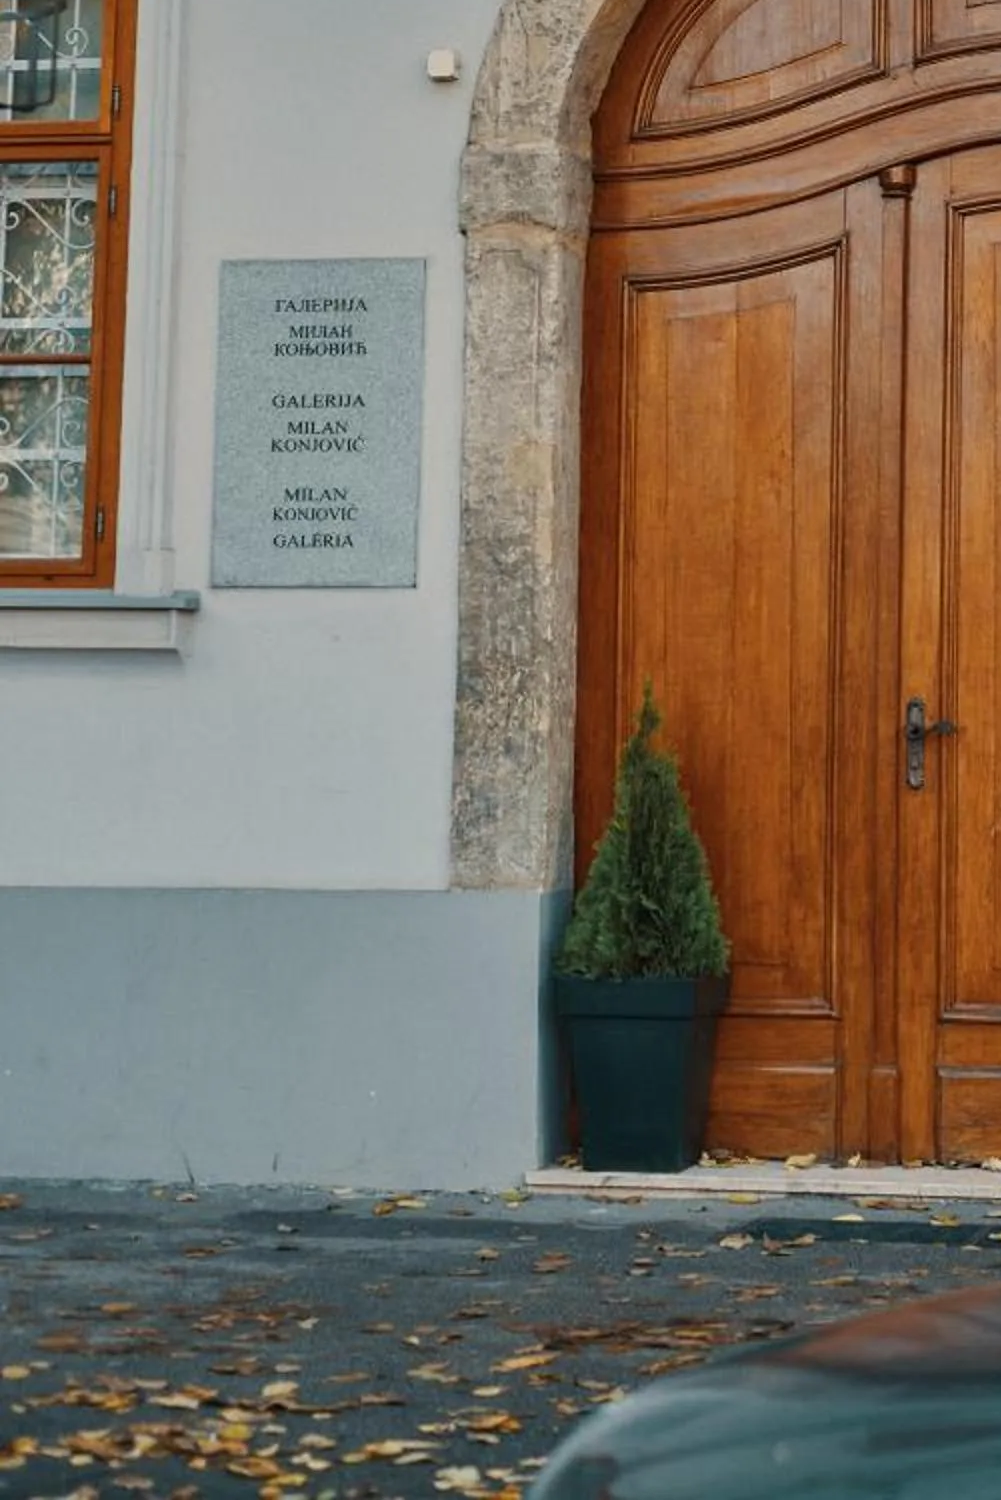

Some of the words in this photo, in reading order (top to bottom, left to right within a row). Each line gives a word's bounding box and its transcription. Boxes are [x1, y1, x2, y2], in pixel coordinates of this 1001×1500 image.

[275, 298, 367, 313] ГАЛЕРИЈА
[289, 324, 353, 339] МИЛАН
[274, 341, 367, 357] КОЊОВИЋ
[272, 394, 365, 409] GALERIJA
[287, 421, 349, 435] MILAN
[271, 436, 366, 453] KONJOVIĆ
[284, 486, 348, 501] MILAN
